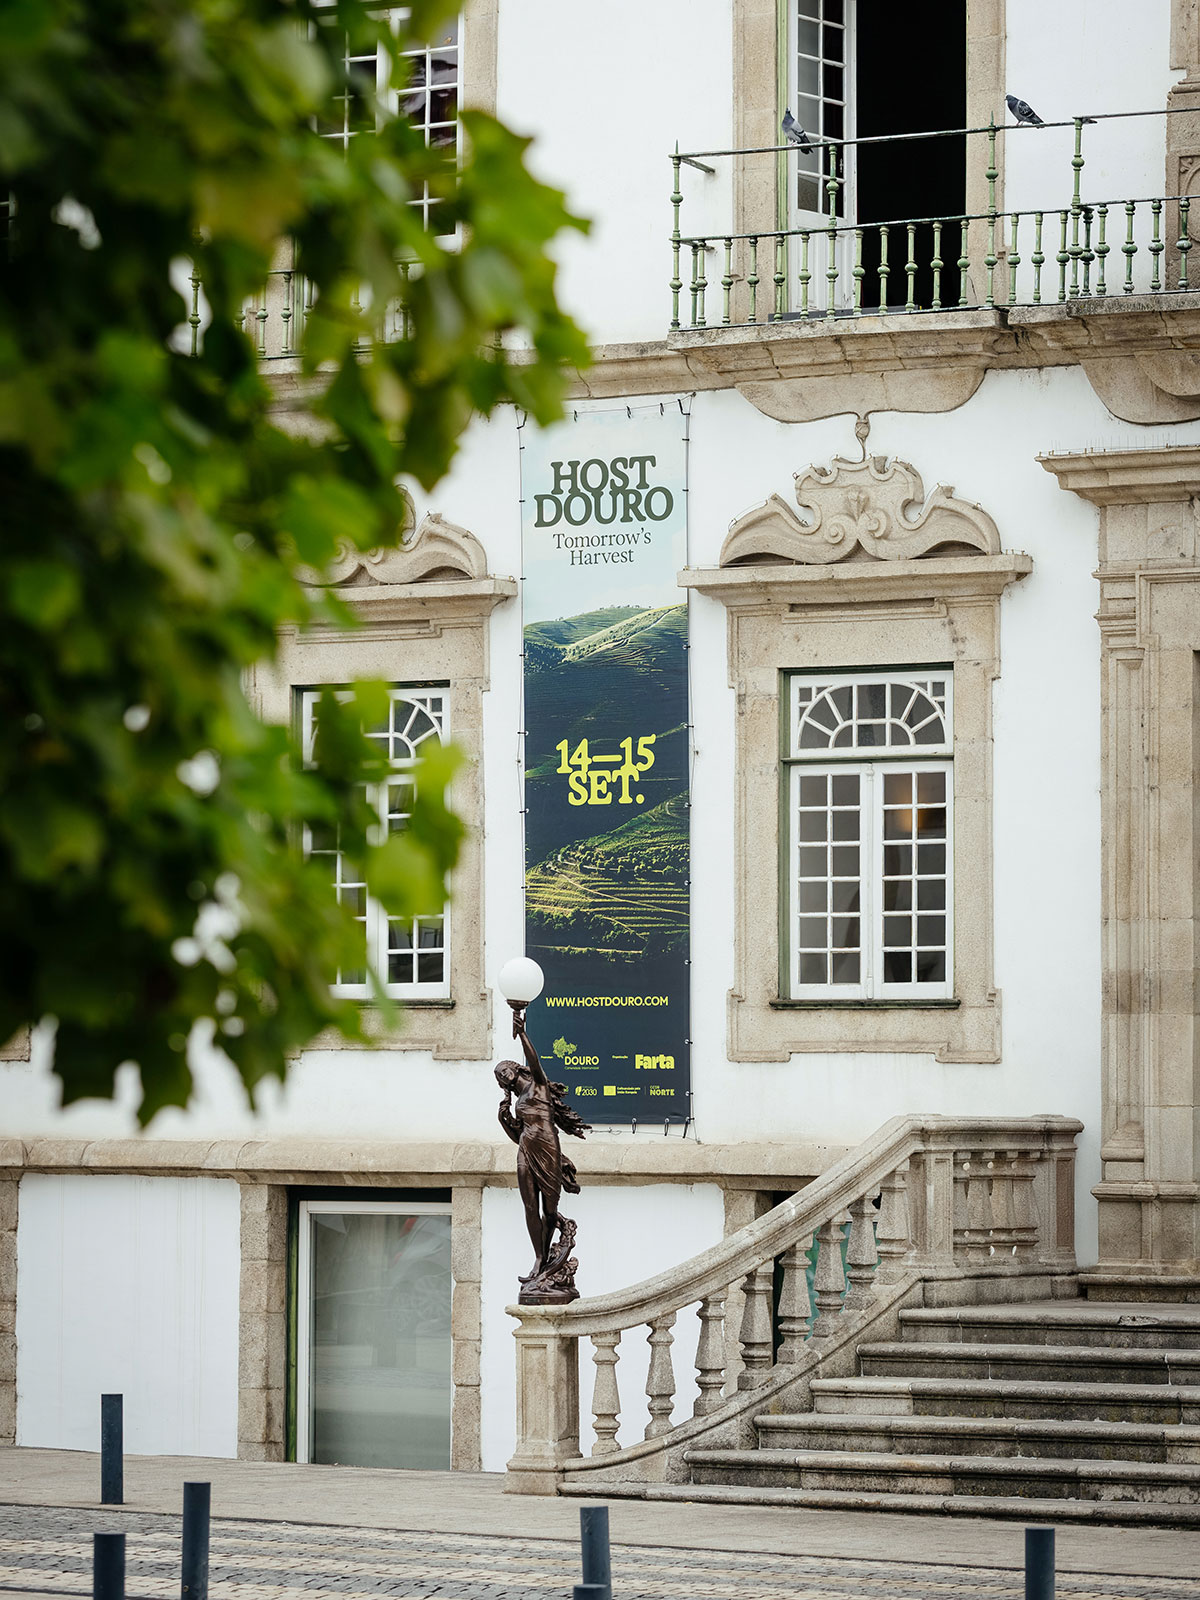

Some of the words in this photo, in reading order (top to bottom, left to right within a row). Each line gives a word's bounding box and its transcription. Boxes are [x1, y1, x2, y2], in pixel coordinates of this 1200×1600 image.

[550, 455, 656, 495] HOST
[533, 486, 674, 528] DOURO
[553, 527, 652, 549] Tomorrow’s
[570, 549, 635, 566] Harvest
[567, 769, 645, 806] SET.
[545, 996, 669, 1008] WWW.HOSTDOURO.COM
[564, 1055, 600, 1066] DOURO
[635, 1054, 675, 1069] Farta
[581, 1088, 598, 1096] 2030
[649, 1088, 675, 1096] NORTE
